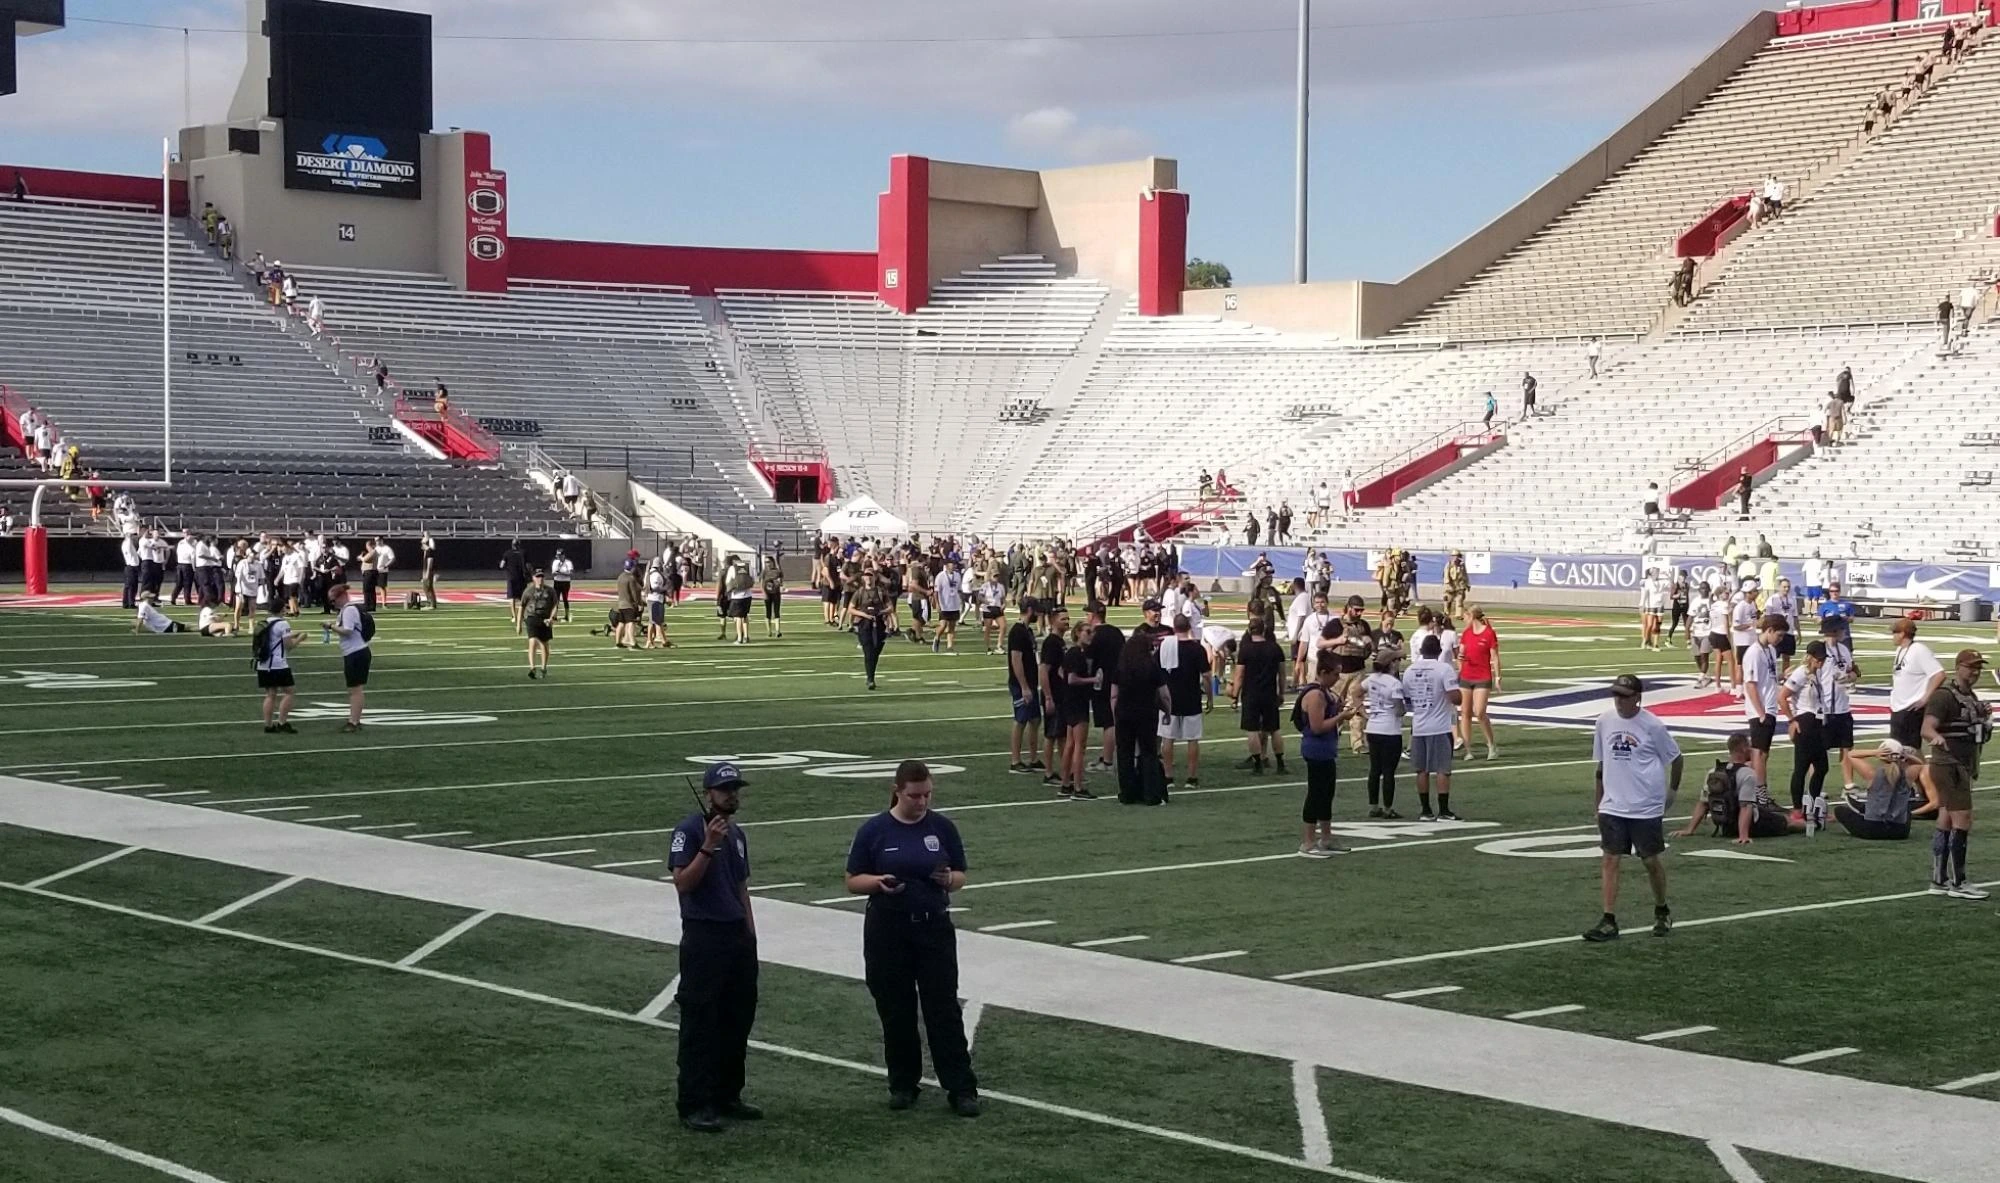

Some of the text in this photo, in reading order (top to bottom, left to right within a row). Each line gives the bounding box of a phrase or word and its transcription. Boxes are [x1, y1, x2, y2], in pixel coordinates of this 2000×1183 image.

[1922, 4, 1940, 19] 17
[296, 155, 414, 177] DESERT DIAMOND
[340, 226, 354, 239] 14
[1225, 295, 1237, 310] 16
[847, 510, 879, 518] TEP
[336, 521, 347, 532] 13
[1550, 562, 1637, 588] CASINO
